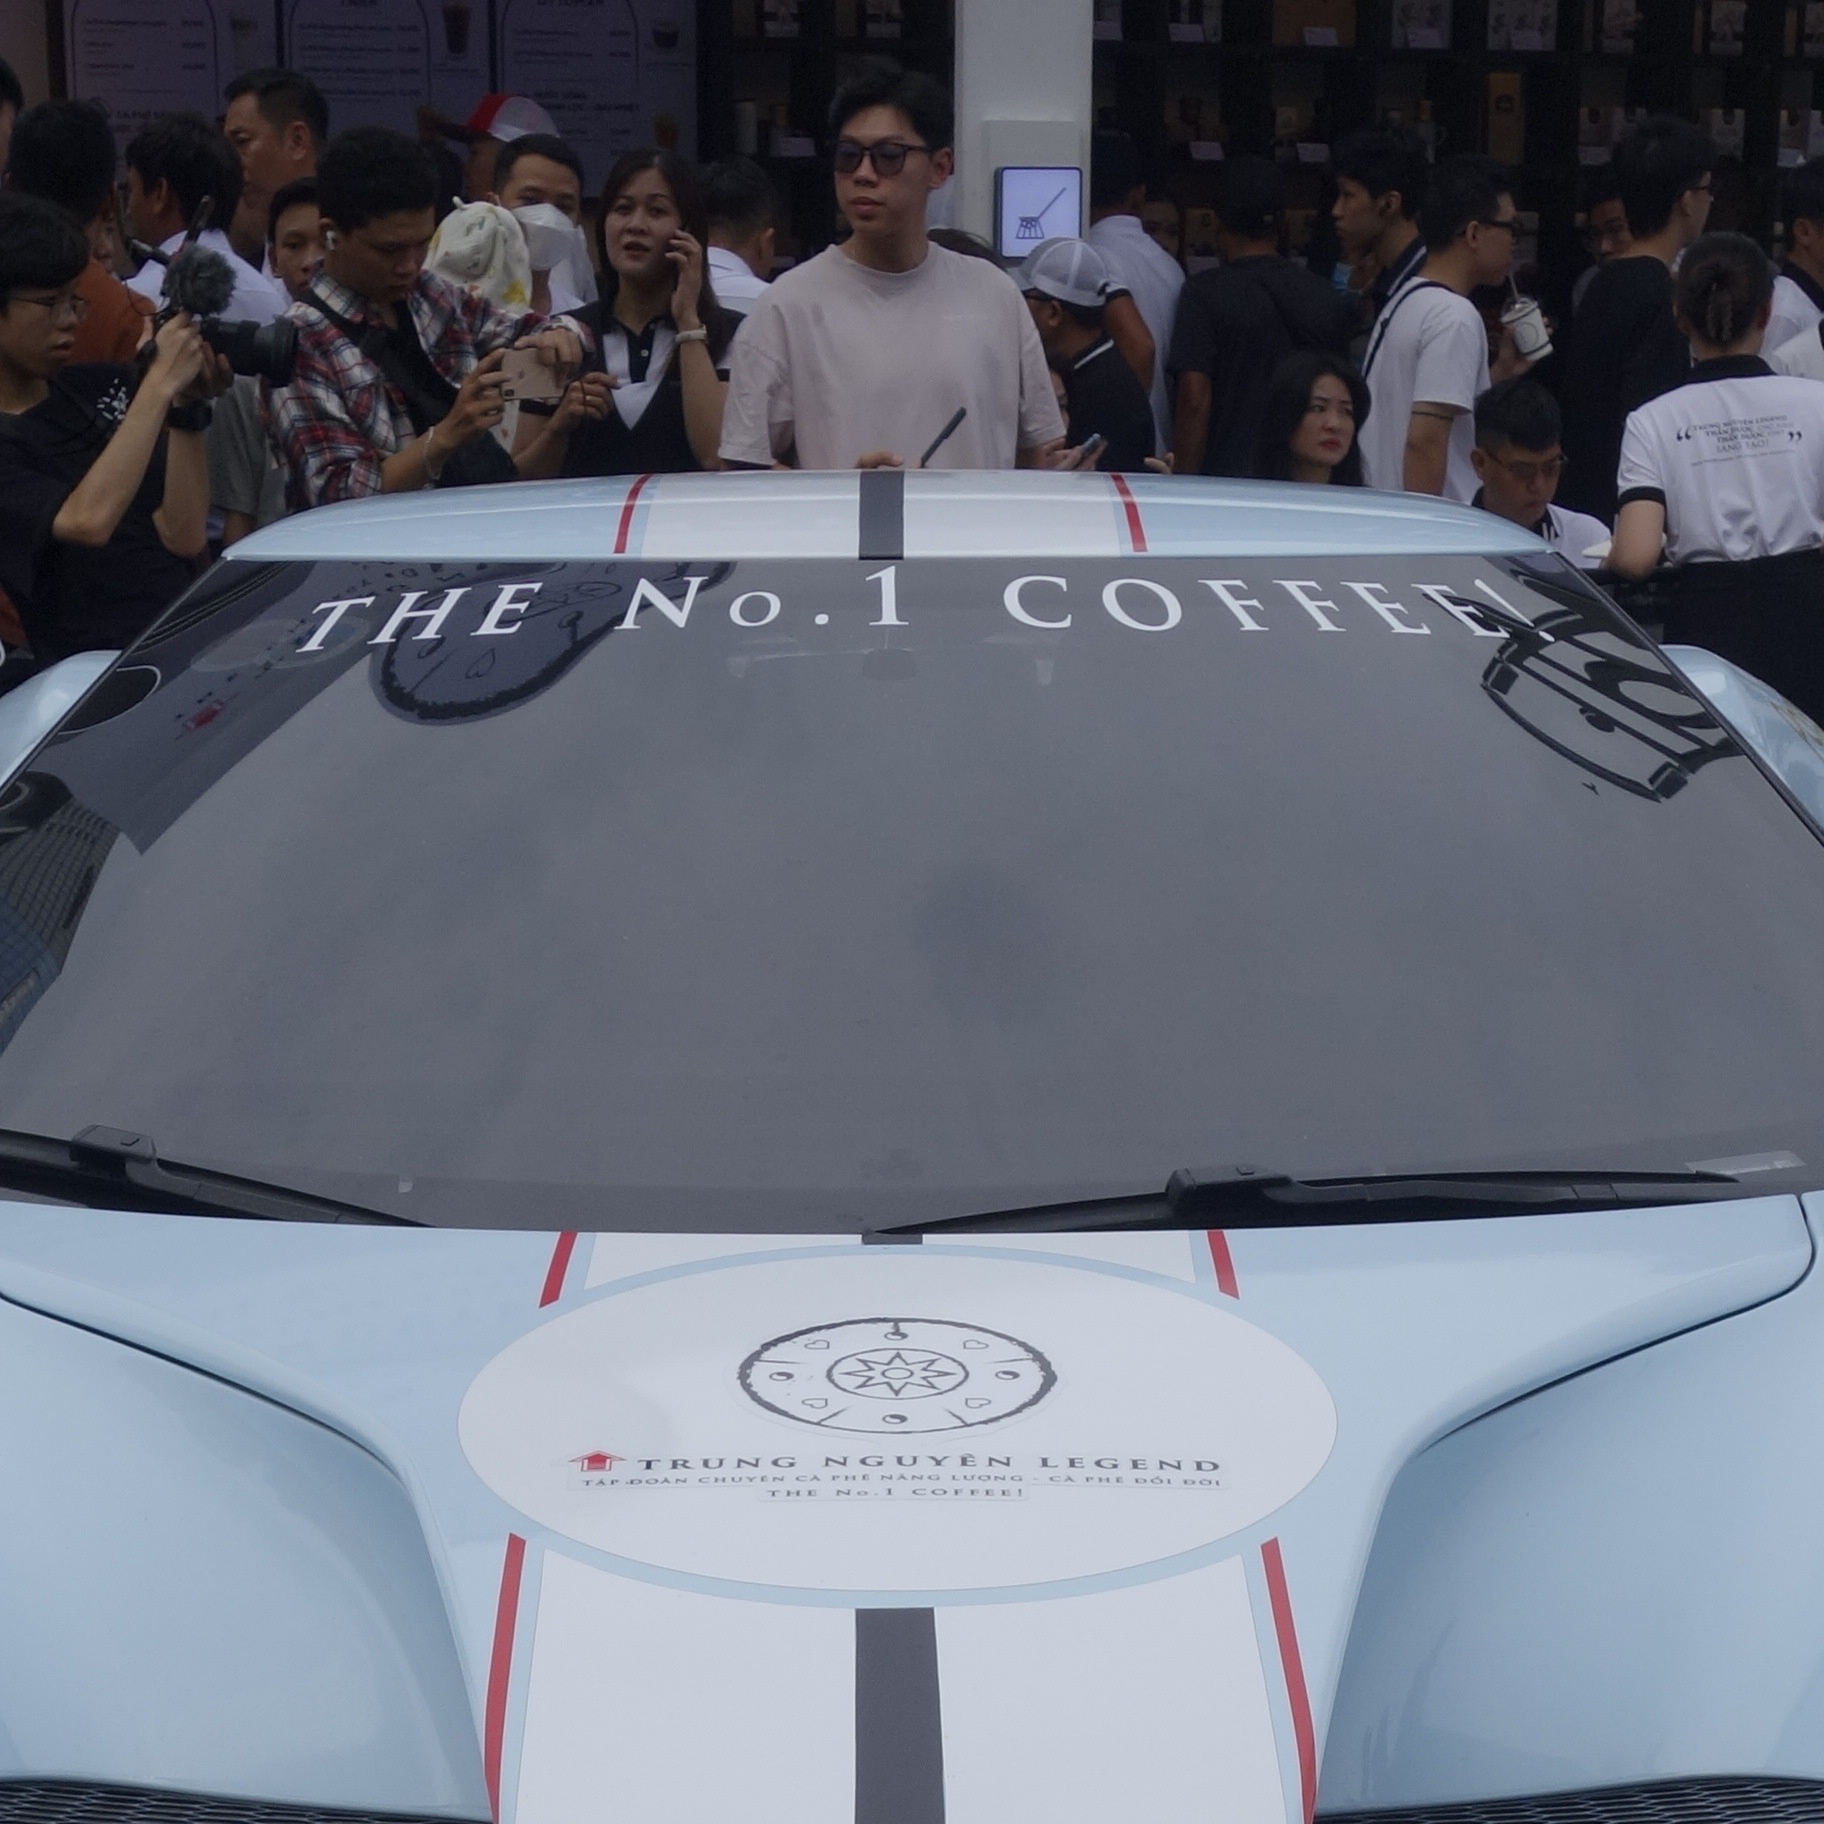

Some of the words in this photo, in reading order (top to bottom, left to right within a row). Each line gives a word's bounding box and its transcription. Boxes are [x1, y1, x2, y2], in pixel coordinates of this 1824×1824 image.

[296, 581, 544, 654] THE
[613, 565, 910, 630] No.1
[1002, 575, 1557, 643] COFFEE!
[637, 1456, 798, 1471] TRUNG
[824, 1453, 1013, 1469] NGUYÊN
[1039, 1456, 1221, 1472] LEGEND
[767, 1489, 817, 1498] THE
[836, 1488, 893, 1498] No.1
[911, 1487, 1024, 1497] COFFEE!
